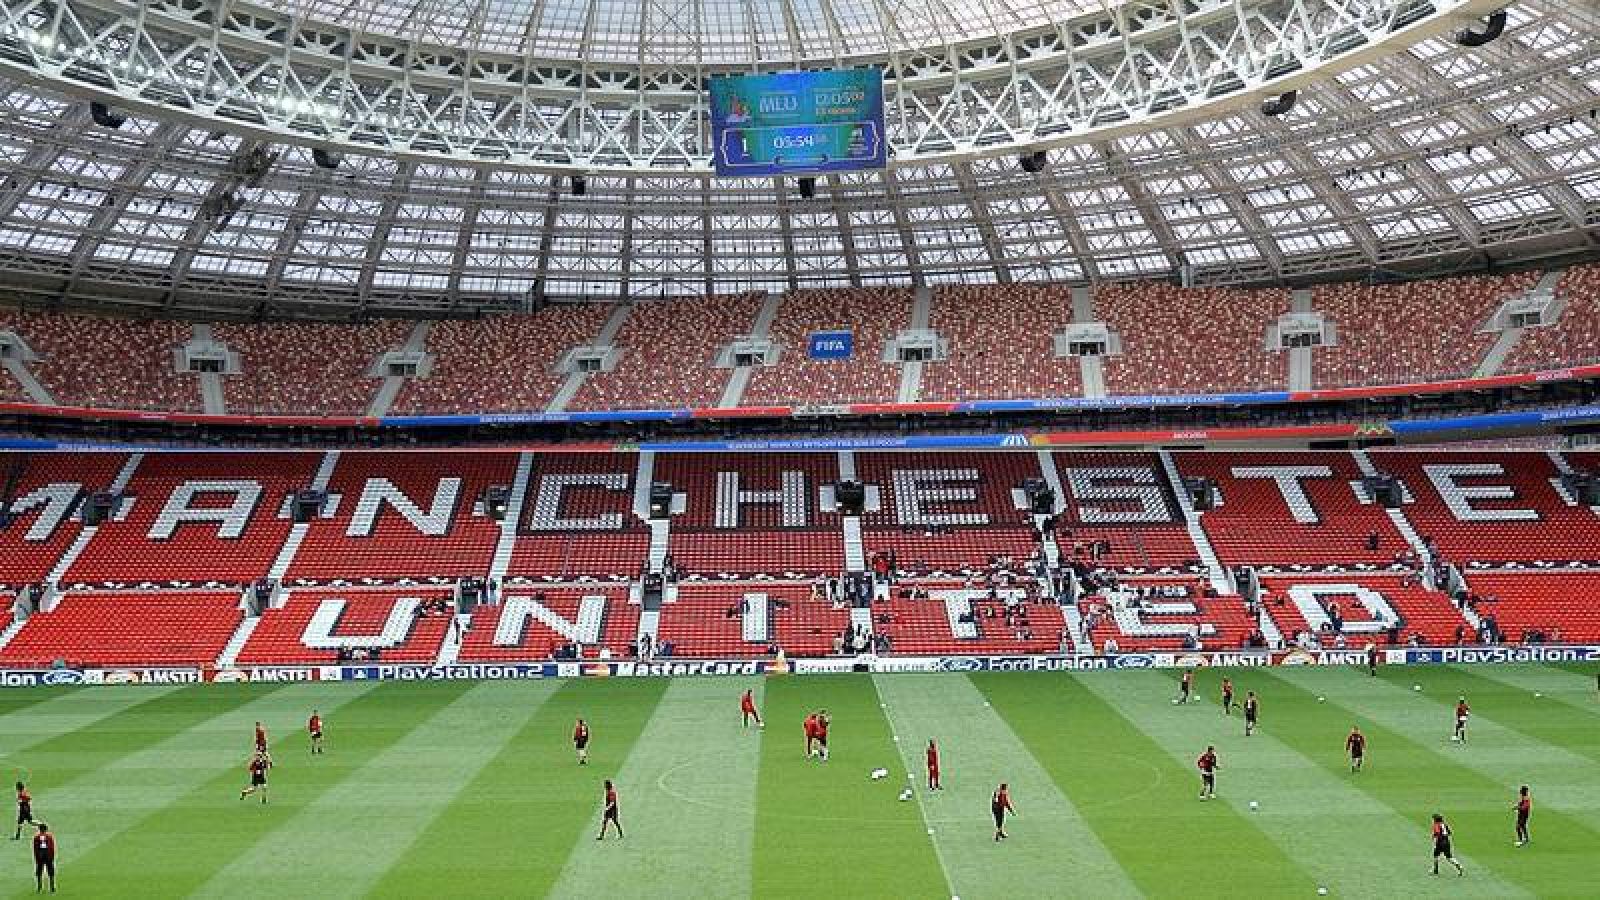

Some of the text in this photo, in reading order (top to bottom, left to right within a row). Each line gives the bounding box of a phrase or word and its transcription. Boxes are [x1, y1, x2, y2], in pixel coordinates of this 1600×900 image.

[815, 341, 845, 351] FIFA
[300, 583, 1401, 650] UNITED
[617, 661, 756, 676] MasterCard
